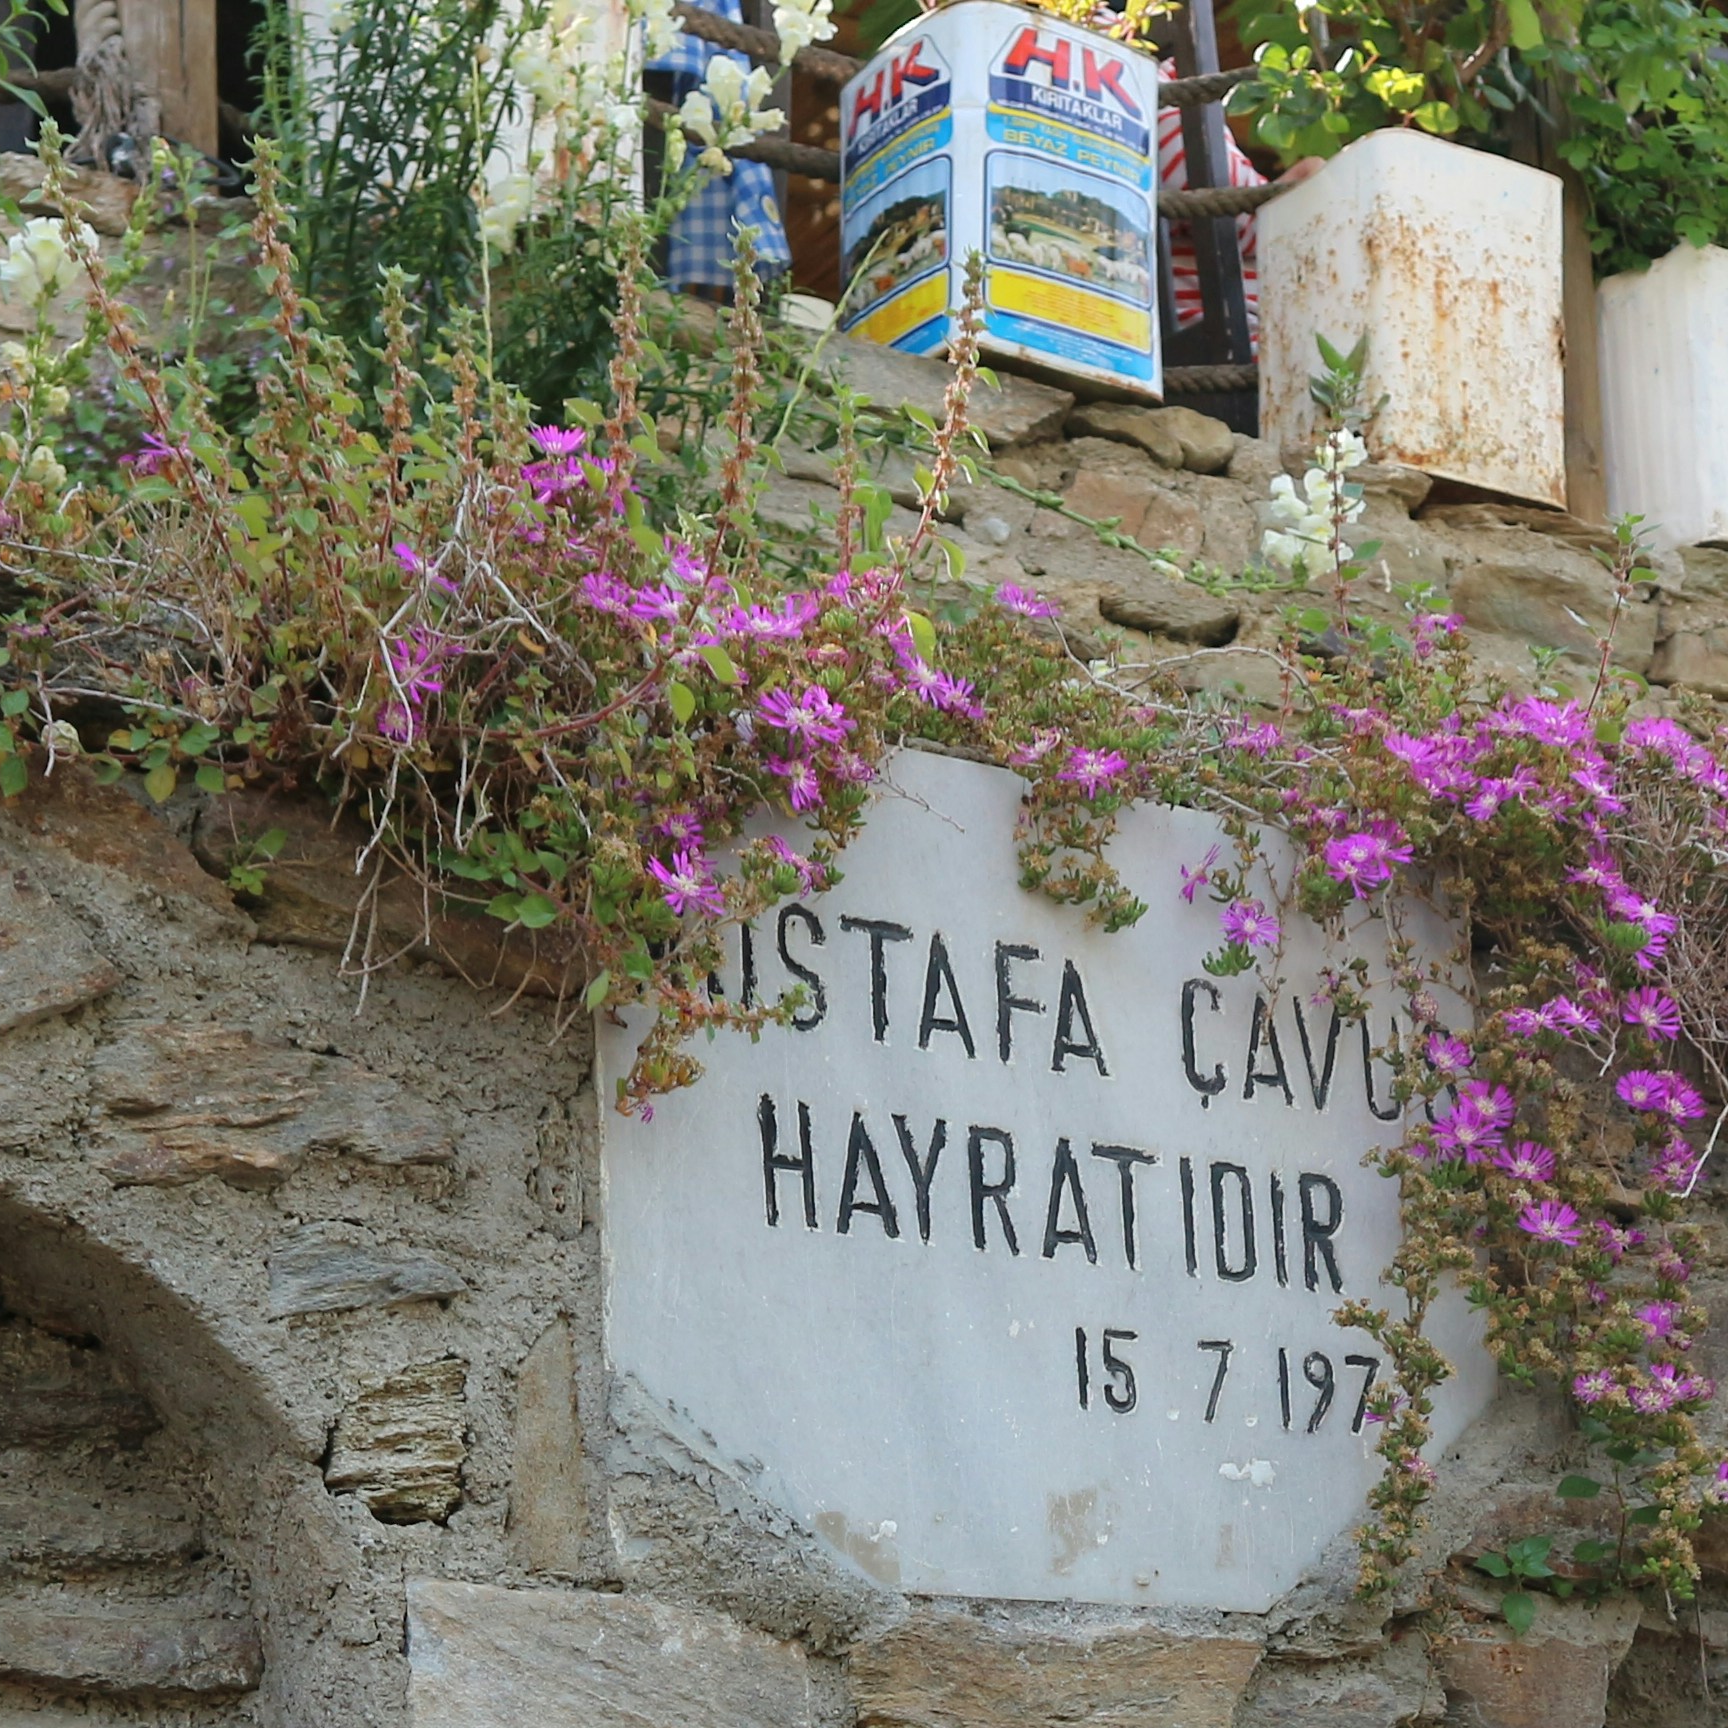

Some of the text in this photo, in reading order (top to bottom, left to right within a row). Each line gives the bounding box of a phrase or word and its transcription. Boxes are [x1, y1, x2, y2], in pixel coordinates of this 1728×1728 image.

[638, 899, 1117, 1078] USTAFA
[757, 1092, 1345, 1294] HAYRATIDIR
[1074, 1326, 1381, 1434] 15 7 197
